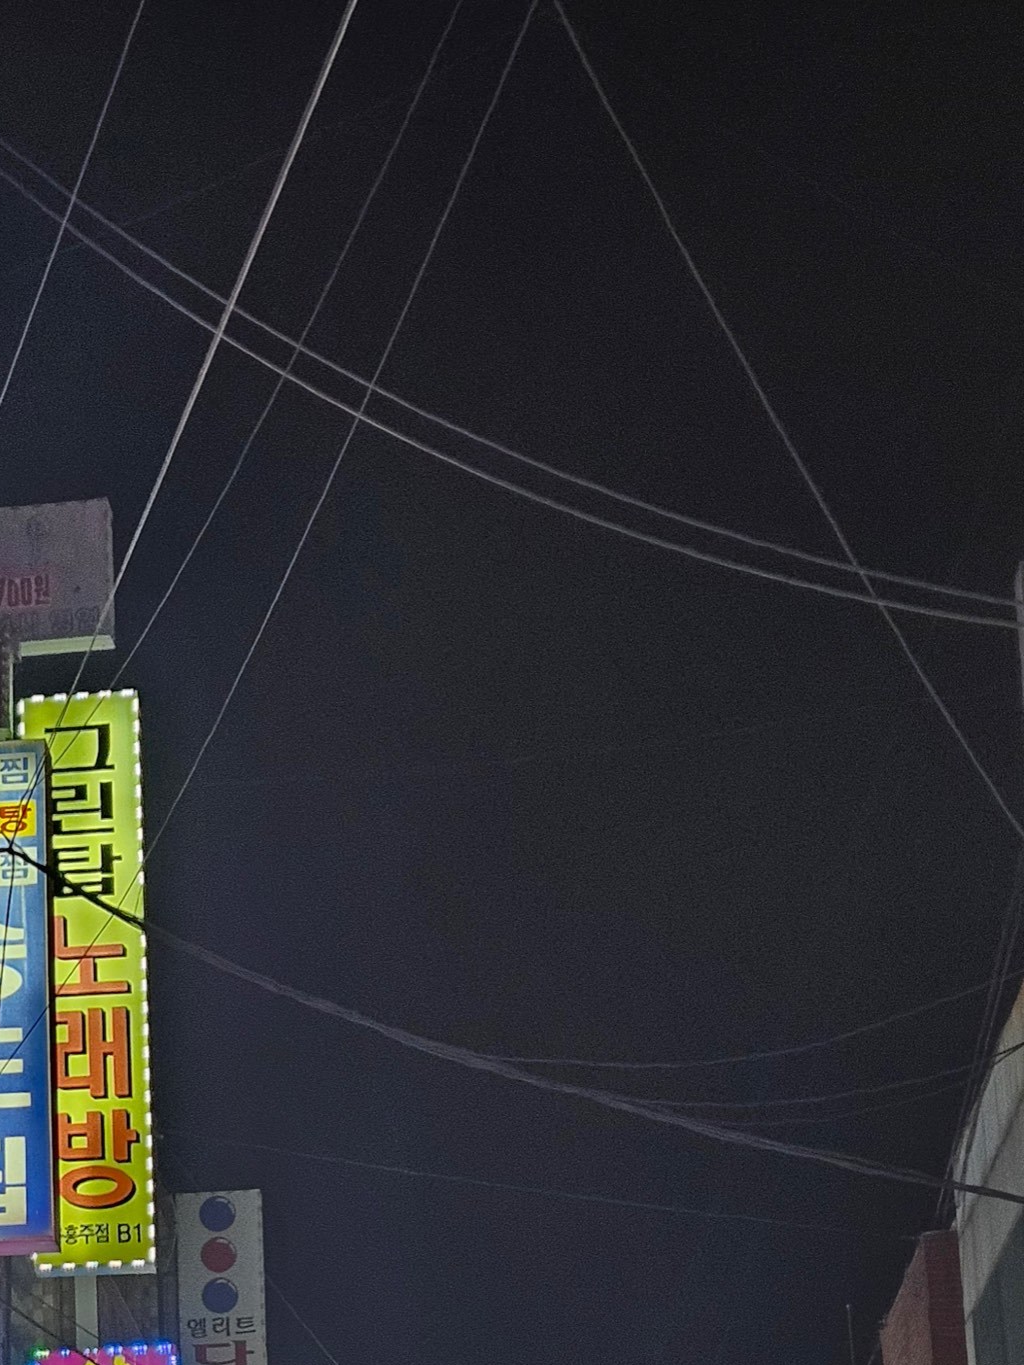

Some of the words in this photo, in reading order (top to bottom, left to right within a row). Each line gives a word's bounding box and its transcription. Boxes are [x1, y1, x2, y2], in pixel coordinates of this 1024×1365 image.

[53, 915, 140, 1209] 노래방
[59, 1223, 110, 1246] 흥주점
[117, 1223, 143, 1245] B1
[186, 1316, 257, 1339] 엘리트
